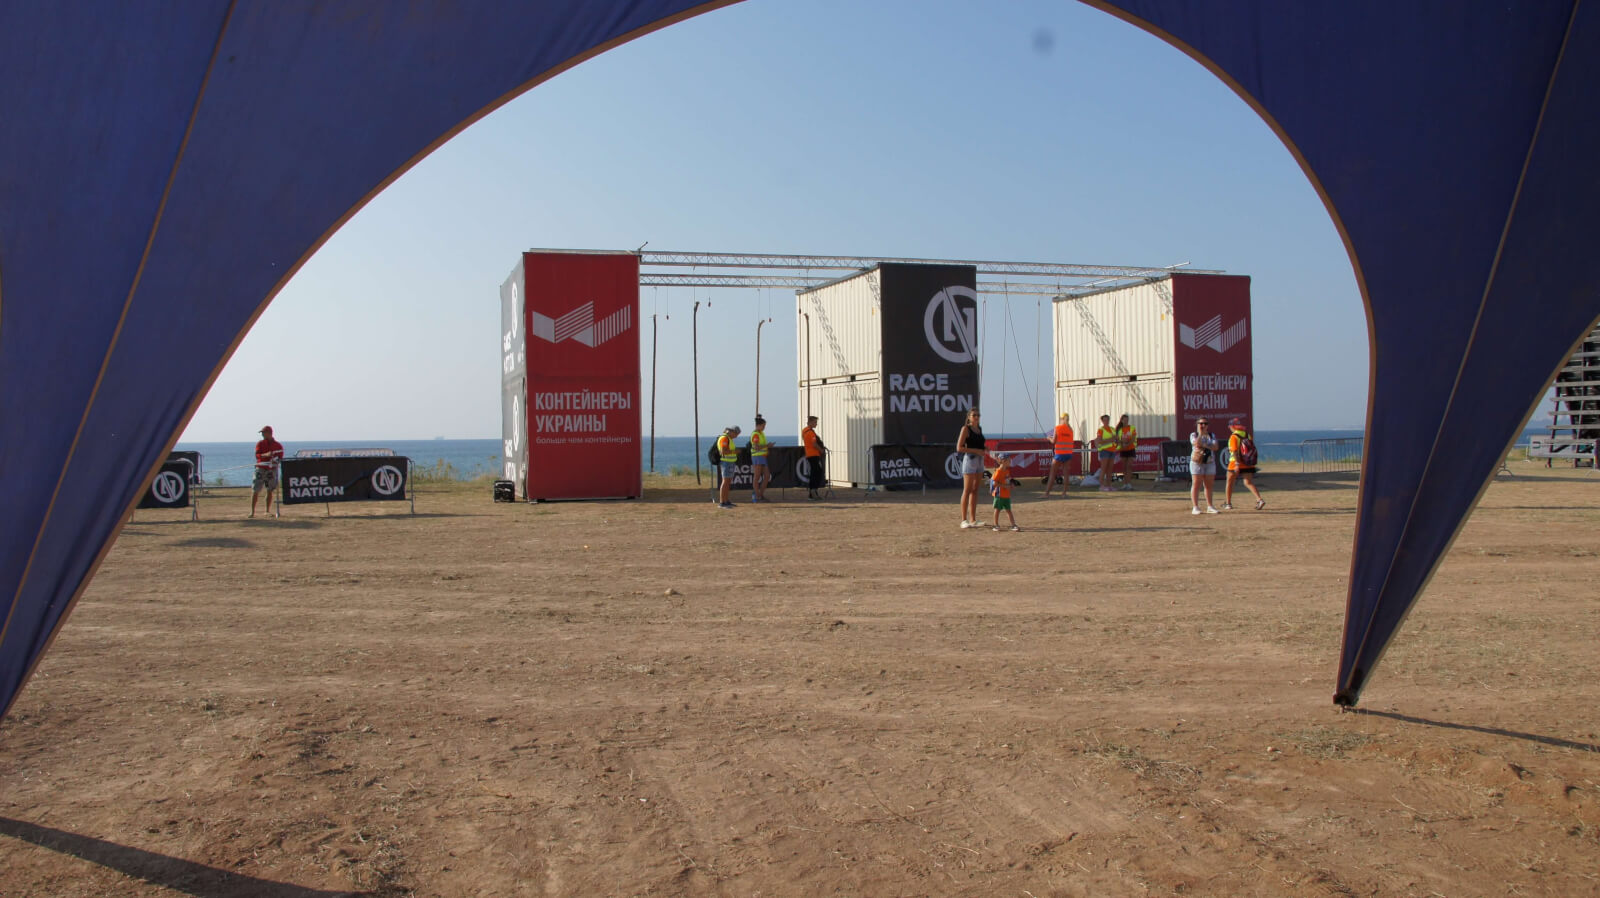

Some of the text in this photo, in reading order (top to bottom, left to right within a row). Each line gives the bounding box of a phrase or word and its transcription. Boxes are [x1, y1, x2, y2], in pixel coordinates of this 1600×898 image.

[889, 373, 949, 391] RACE
[1182, 372, 1247, 391] КОНТЕЙНЕРИ
[535, 388, 631, 410] КОНТЕЙНЕРЫ
[889, 394, 973, 413] NATION
[1183, 391, 1228, 410] УКРАЇНИ
[535, 414, 607, 432] УКРАИНЫ
[880, 458, 911, 470] RACE
[1167, 465, 1191, 473] NATI
[289, 476, 329, 487] RACE
[880, 468, 923, 480] NATION
[289, 486, 345, 499] NATION
